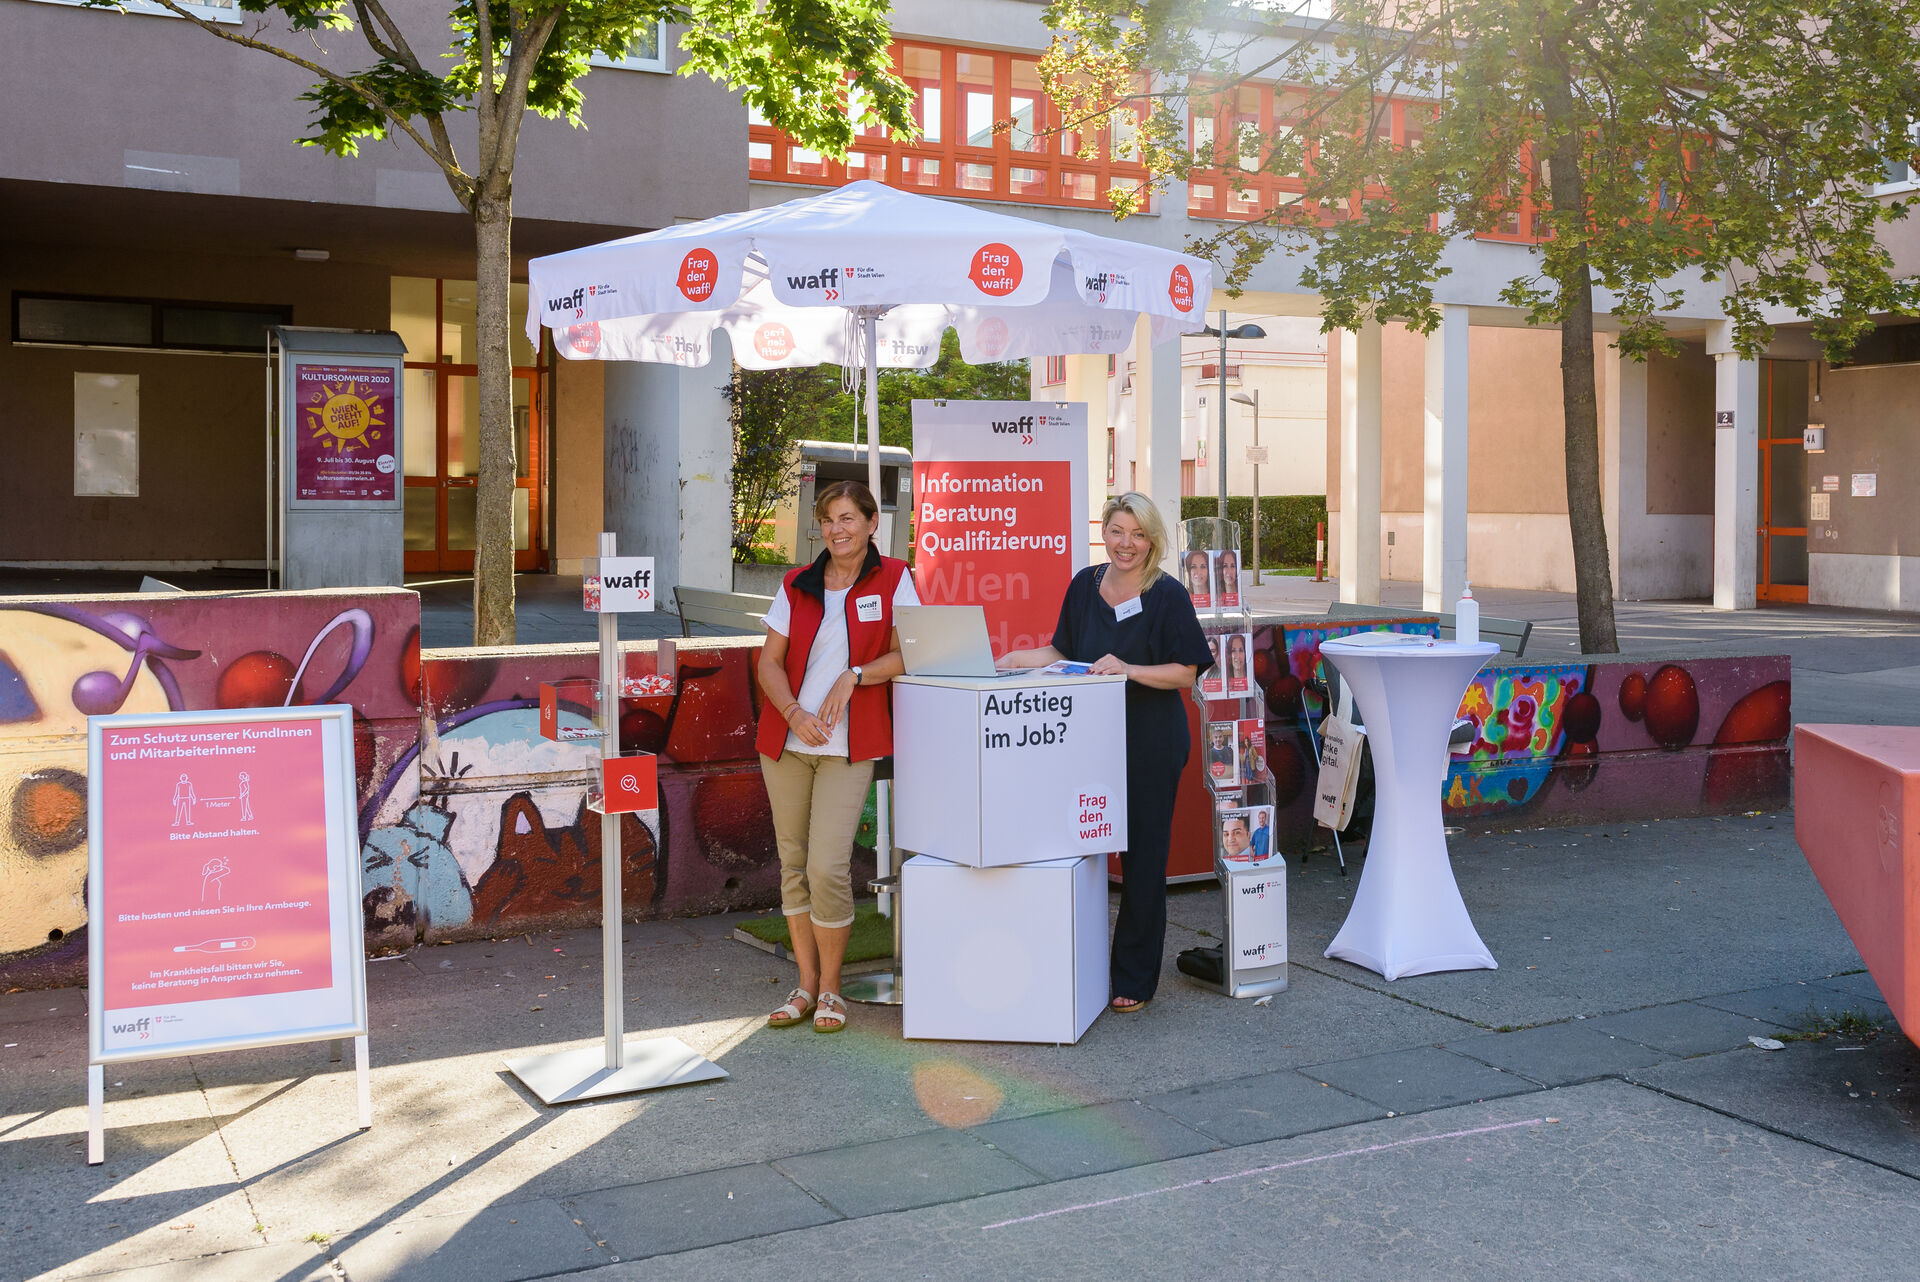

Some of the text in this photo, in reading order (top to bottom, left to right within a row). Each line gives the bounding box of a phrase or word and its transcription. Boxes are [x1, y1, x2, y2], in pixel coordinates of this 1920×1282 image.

[687, 258, 709, 271] Frag
[981, 251, 1010, 267] Frag
[687, 273, 706, 282] den
[981, 265, 1005, 277] den
[1174, 271, 1189, 286] Frag
[787, 268, 839, 290] waff
[981, 278, 1014, 290] waff!
[1086, 273, 1107, 292] waff
[686, 283, 711, 295] waff!
[1174, 285, 1189, 295] den
[549, 288, 585, 312] waff
[302, 373, 390, 383] KULTURSOMMER 2020
[330, 410, 363, 423] DREHT
[331, 404, 358, 414] WIEN
[338, 420, 360, 429] AUF!
[992, 416, 1033, 434] waff
[1722, 413, 1728, 422] 2
[354, 457, 375, 465] August
[920, 472, 1044, 493] Information
[921, 502, 1017, 527] Beratung
[921, 530, 1067, 556] Qualifizierung
[604, 570, 651, 589] waff
[915, 561, 1030, 603] Wien
[858, 601, 877, 609] waff
[984, 691, 1073, 717] Aufstieg
[110, 727, 313, 746] Zum Schutz unserer KundInnen
[985, 722, 1067, 748] im Job?
[110, 744, 257, 761] und MitarbeiterInnen:
[1323, 742, 1339, 755] enke
[1322, 756, 1339, 769] gital.
[1079, 794, 1107, 809] Frag
[1079, 809, 1103, 823] den
[192, 830, 229, 839] Abstand
[1079, 823, 1112, 839] waff!
[1242, 884, 1265, 895] waff
[118, 914, 140, 922] Bitte
[141, 912, 172, 920] husten
[173, 909, 191, 917] und
[192, 908, 220, 917] niesen
[222, 906, 235, 914] Sie
[264, 901, 312, 910] Armbeuge.
[1243, 945, 1266, 956] waff
[163, 964, 225, 977] Krankheitsfall
[226, 963, 253, 972] bitten
[253, 961, 268, 969] wir
[269, 959, 285, 968] Sie,
[131, 968, 303, 990] keine Beratung in Anspruch zu nehmen.
[113, 1018, 150, 1034] waff
